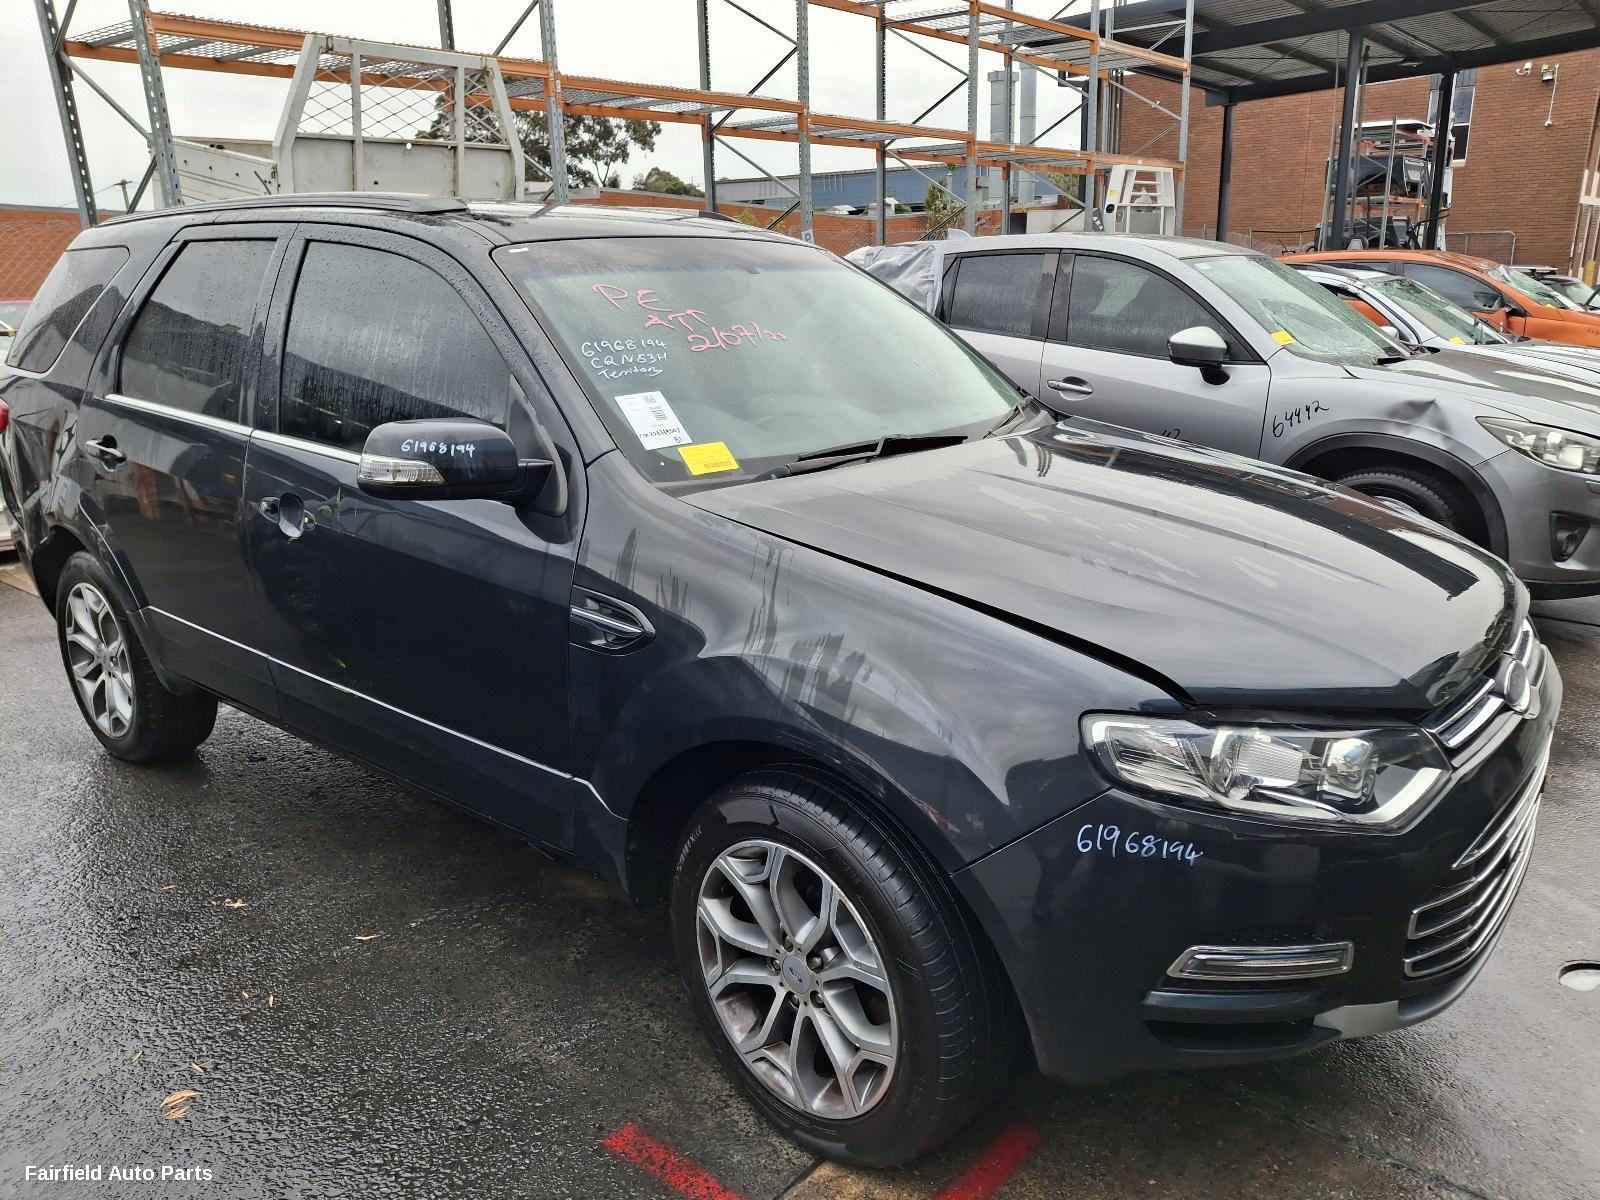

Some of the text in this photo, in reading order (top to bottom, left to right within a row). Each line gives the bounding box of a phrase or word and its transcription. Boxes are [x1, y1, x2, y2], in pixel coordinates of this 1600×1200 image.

[581, 338, 667, 357] 61968194
[401, 439, 476, 458] 61968194
[1076, 823, 1204, 867] 61968194
